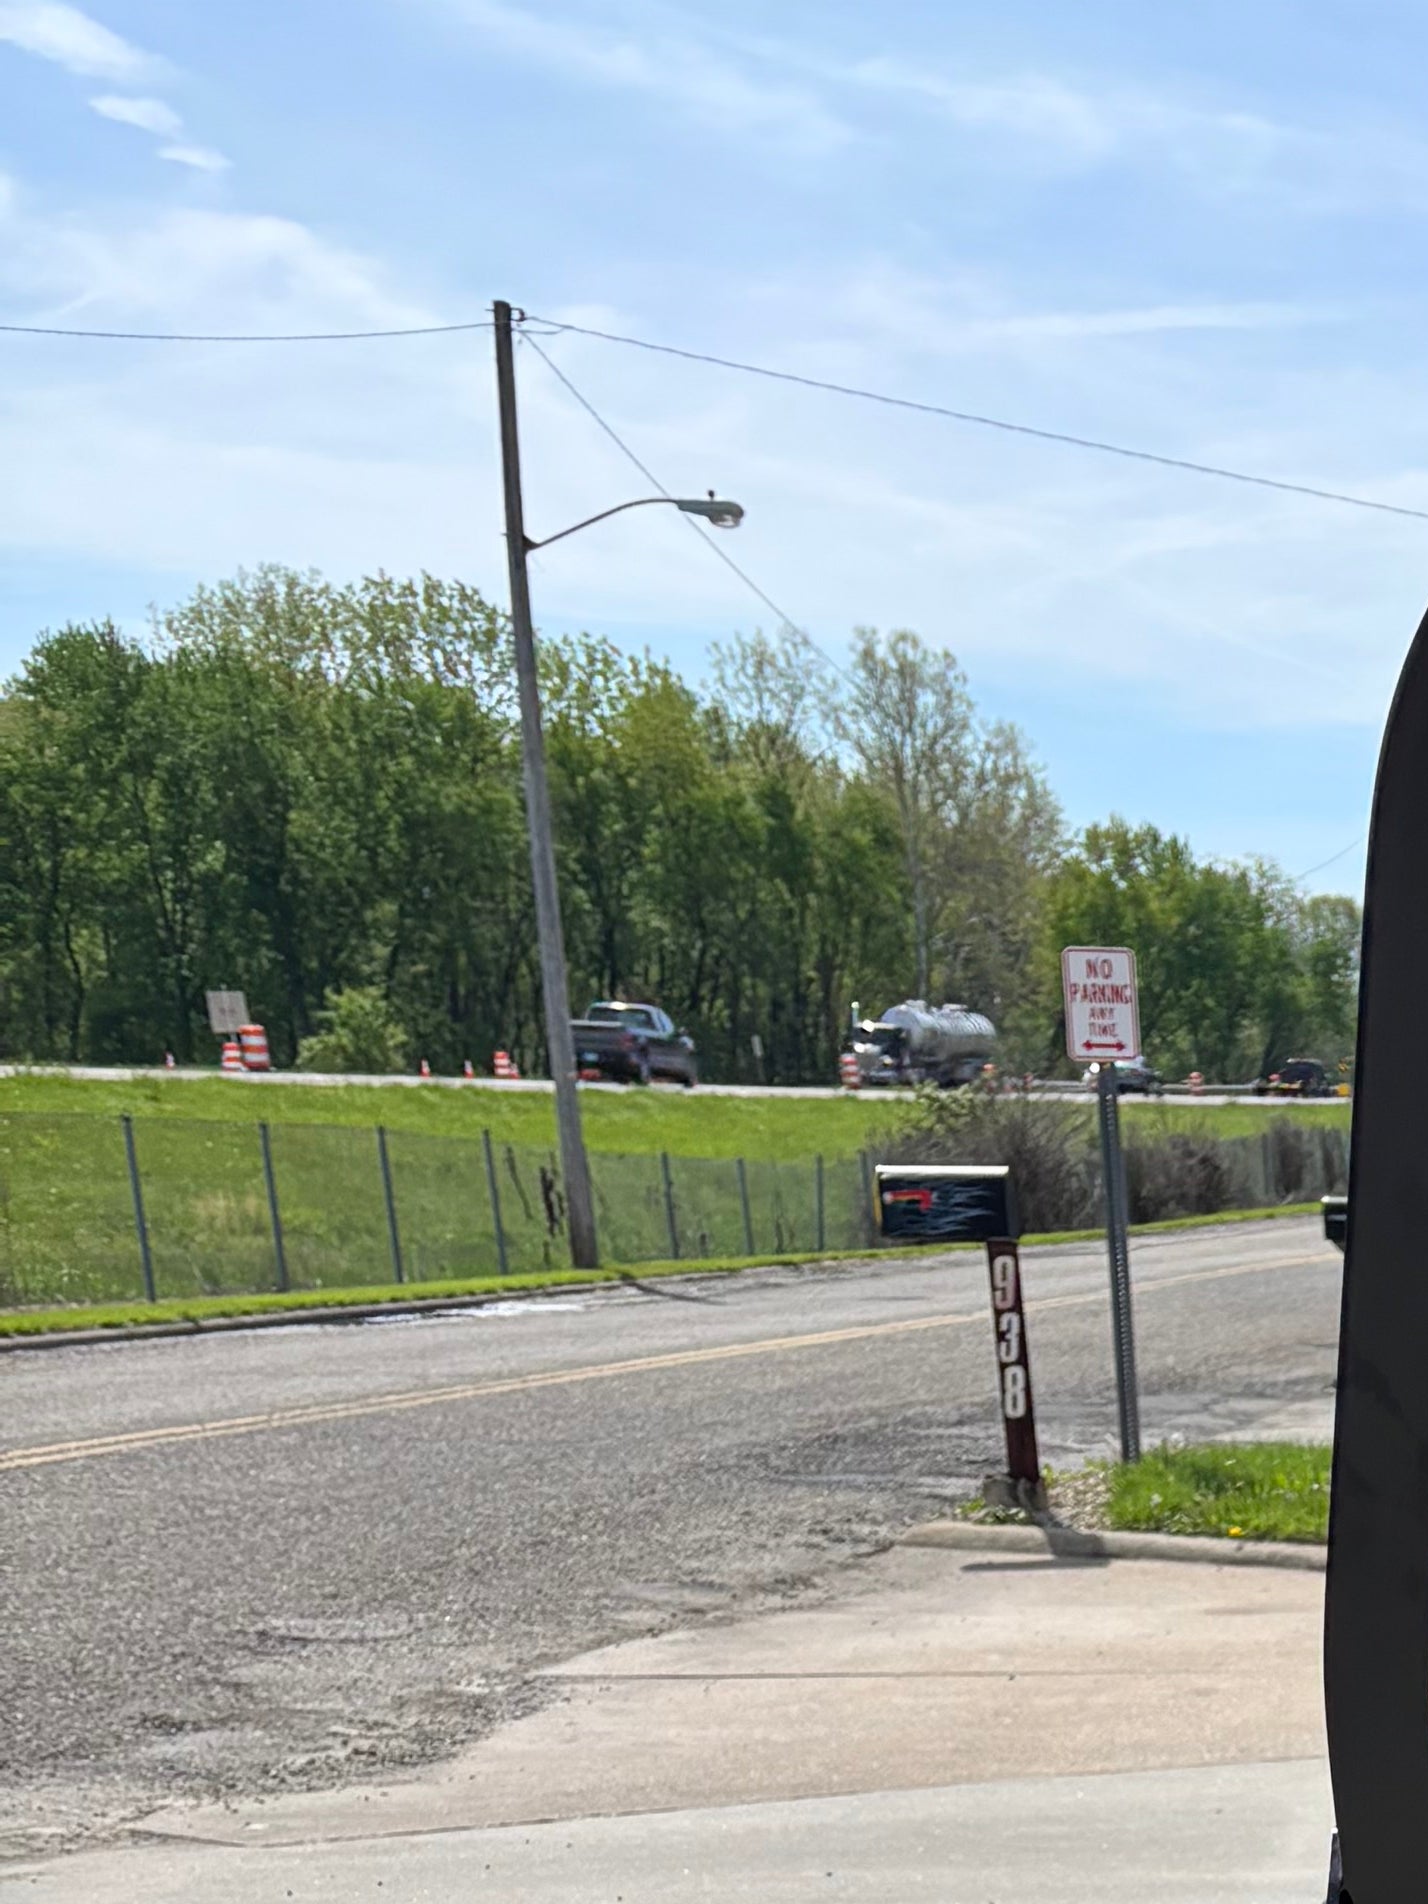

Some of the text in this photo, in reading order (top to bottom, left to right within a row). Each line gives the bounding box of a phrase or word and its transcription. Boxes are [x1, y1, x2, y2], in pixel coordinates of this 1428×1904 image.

[1085, 959, 1113, 979] NO
[1069, 983, 1132, 1004] PARKING
[993, 1255, 1026, 1419] 938
